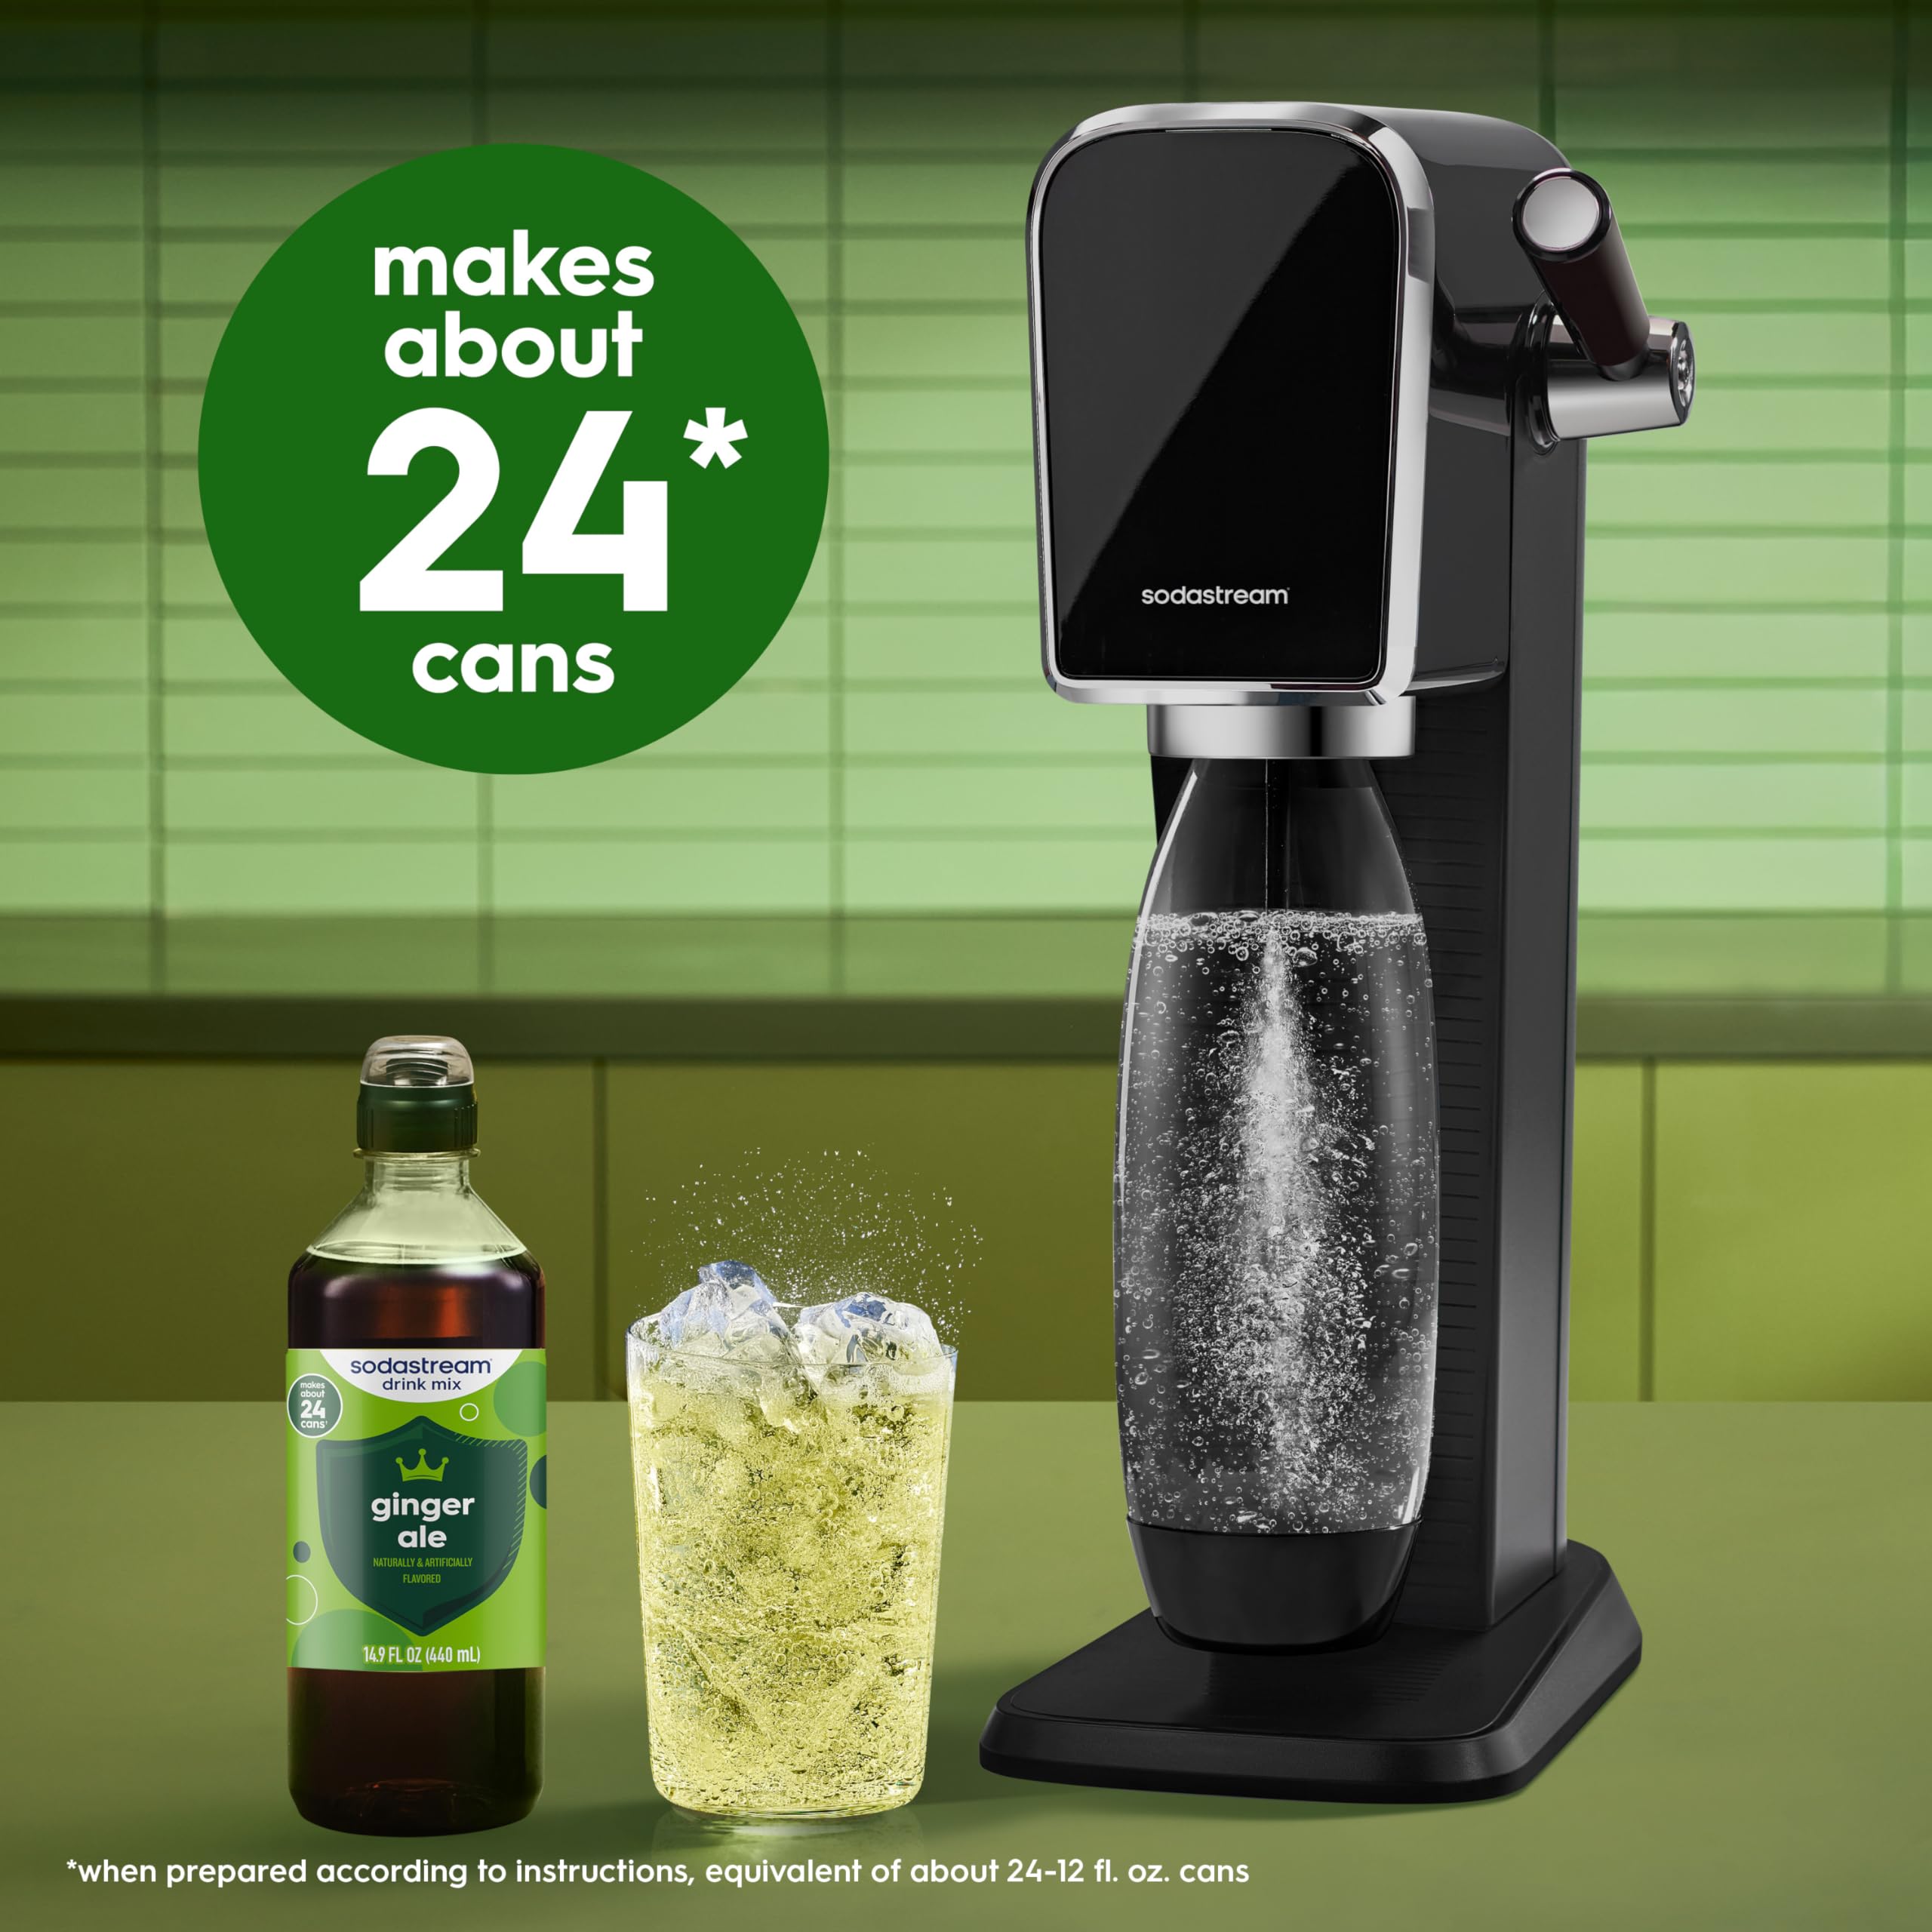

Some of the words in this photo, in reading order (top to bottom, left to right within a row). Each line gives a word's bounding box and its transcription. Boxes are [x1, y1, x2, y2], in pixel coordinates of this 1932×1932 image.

[1141, 585, 1291, 605] sodastream
[350, 1357, 492, 1374] sodastream
[300, 1380, 325, 1389] makes
[382, 1377, 426, 1390] drink
[432, 1377, 461, 1390] mix
[300, 1389, 325, 1398] about
[300, 1399, 326, 1419] 24
[371, 1491, 475, 1522] ginger
[398, 1524, 448, 1548] ale
[373, 1557, 415, 1567] NATURALLY
[417, 1558, 423, 1567] &
[424, 1557, 473, 1567] ARTIFICIALLY
[402, 1574, 441, 1583] FLAVORED
[363, 1646, 386, 1663] 14.9
[389, 1646, 403, 1663] FL
[407, 1646, 422, 1663] OZ
[425, 1645, 453, 1665] (440
[457, 1645, 481, 1664] mL)
